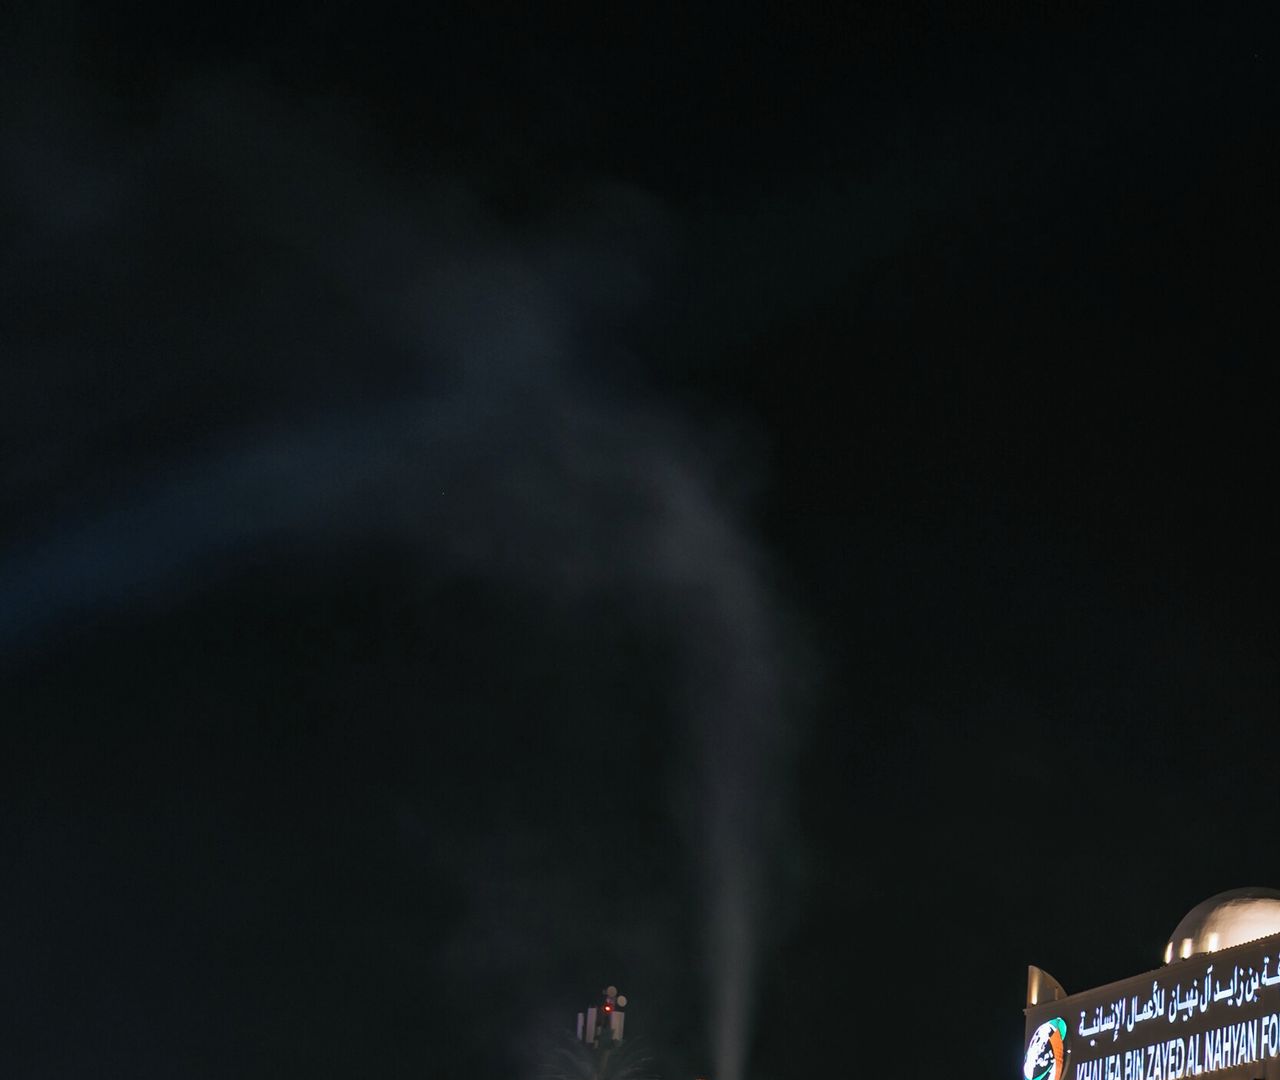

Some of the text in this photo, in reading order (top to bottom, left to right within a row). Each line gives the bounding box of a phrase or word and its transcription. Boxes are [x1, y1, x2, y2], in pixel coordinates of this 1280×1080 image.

[1127, 980, 1165, 1033] للأعمال
[1168, 979, 1199, 1024] نهيان
[1200, 964, 1213, 1013] آل
[1213, 965, 1245, 1008] زايد
[1245, 967, 1260, 1003] بن
[1079, 996, 1126, 1047] الإنسانية
[1185, 1033, 1202, 1077] AL
[1203, 1018, 1257, 1074] NAHYAN
